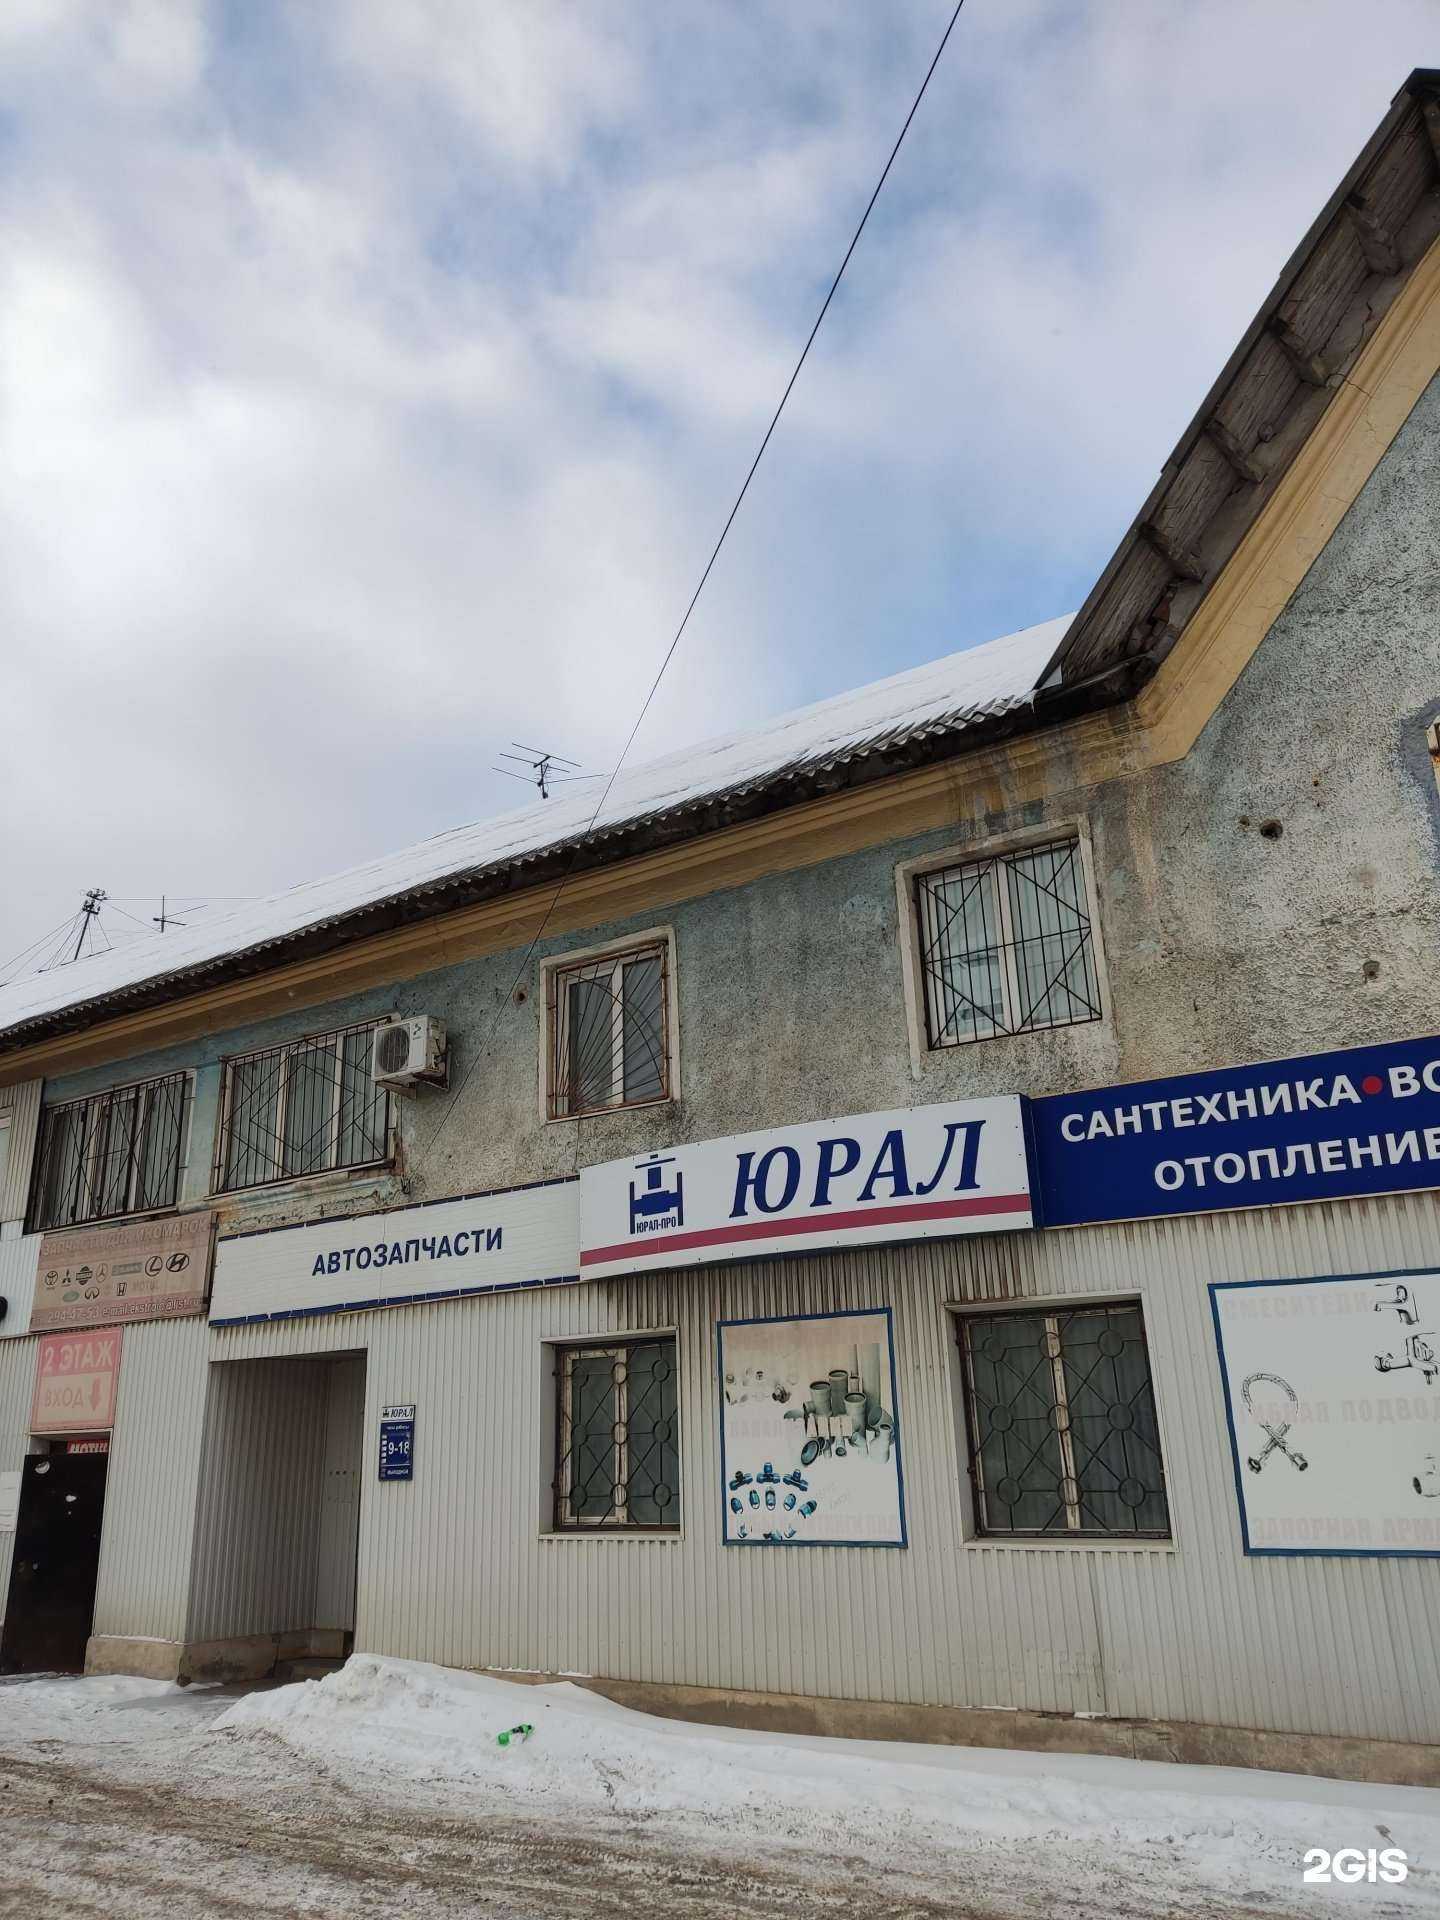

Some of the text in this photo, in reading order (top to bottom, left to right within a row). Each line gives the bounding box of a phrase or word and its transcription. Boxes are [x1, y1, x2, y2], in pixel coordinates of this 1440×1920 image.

[1060, 1074, 1363, 1143] САНТЕХНИКА
[728, 1119, 987, 1219] ЮРАЛ
[1154, 1126, 1440, 1191] ОТОПЛЕНИЕ
[636, 1216, 677, 1234] ЮРАЛ-ПРО
[311, 1227, 503, 1276] АВТОЗАПЧАСТИ
[43, 1340, 115, 1373] 2 ЭТАЖ
[44, 1386, 85, 1409] ВХОД
[390, 1408, 414, 1418] ЮРАЛ
[388, 1441, 410, 1455] 9-18
